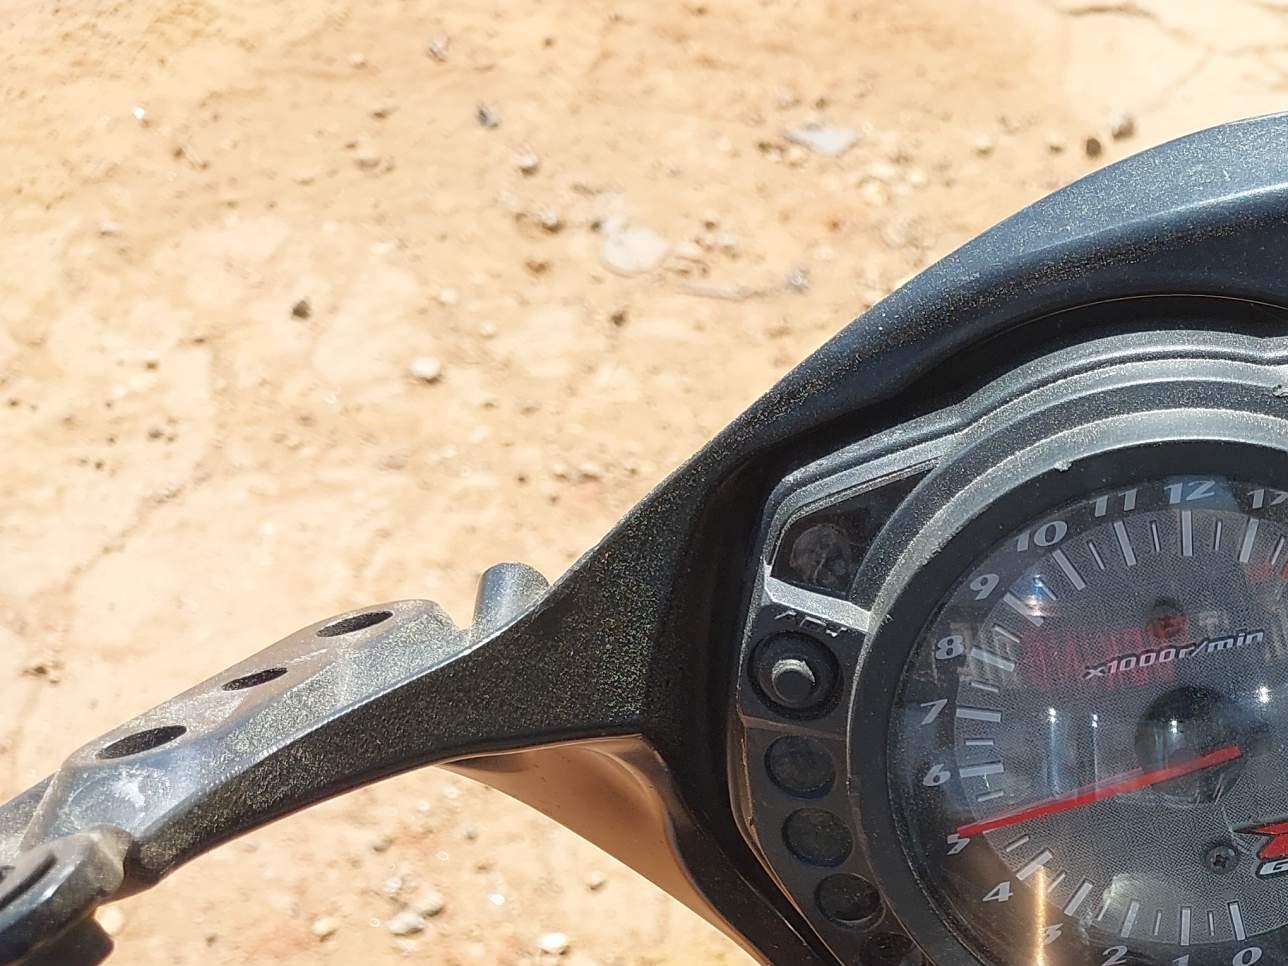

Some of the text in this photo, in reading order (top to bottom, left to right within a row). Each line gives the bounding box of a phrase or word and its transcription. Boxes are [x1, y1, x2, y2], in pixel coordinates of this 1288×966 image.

[1094, 487, 1138, 518] 11
[1164, 479, 1216, 505] 12
[1014, 520, 1068, 552] 10
[970, 573, 1000, 600] 9
[935, 635, 965, 661] 8
[1082, 627, 1265, 681] x1000r/min
[920, 698, 948, 726] 7
[922, 763, 951, 787] 6
[982, 880, 1014, 903] 4
